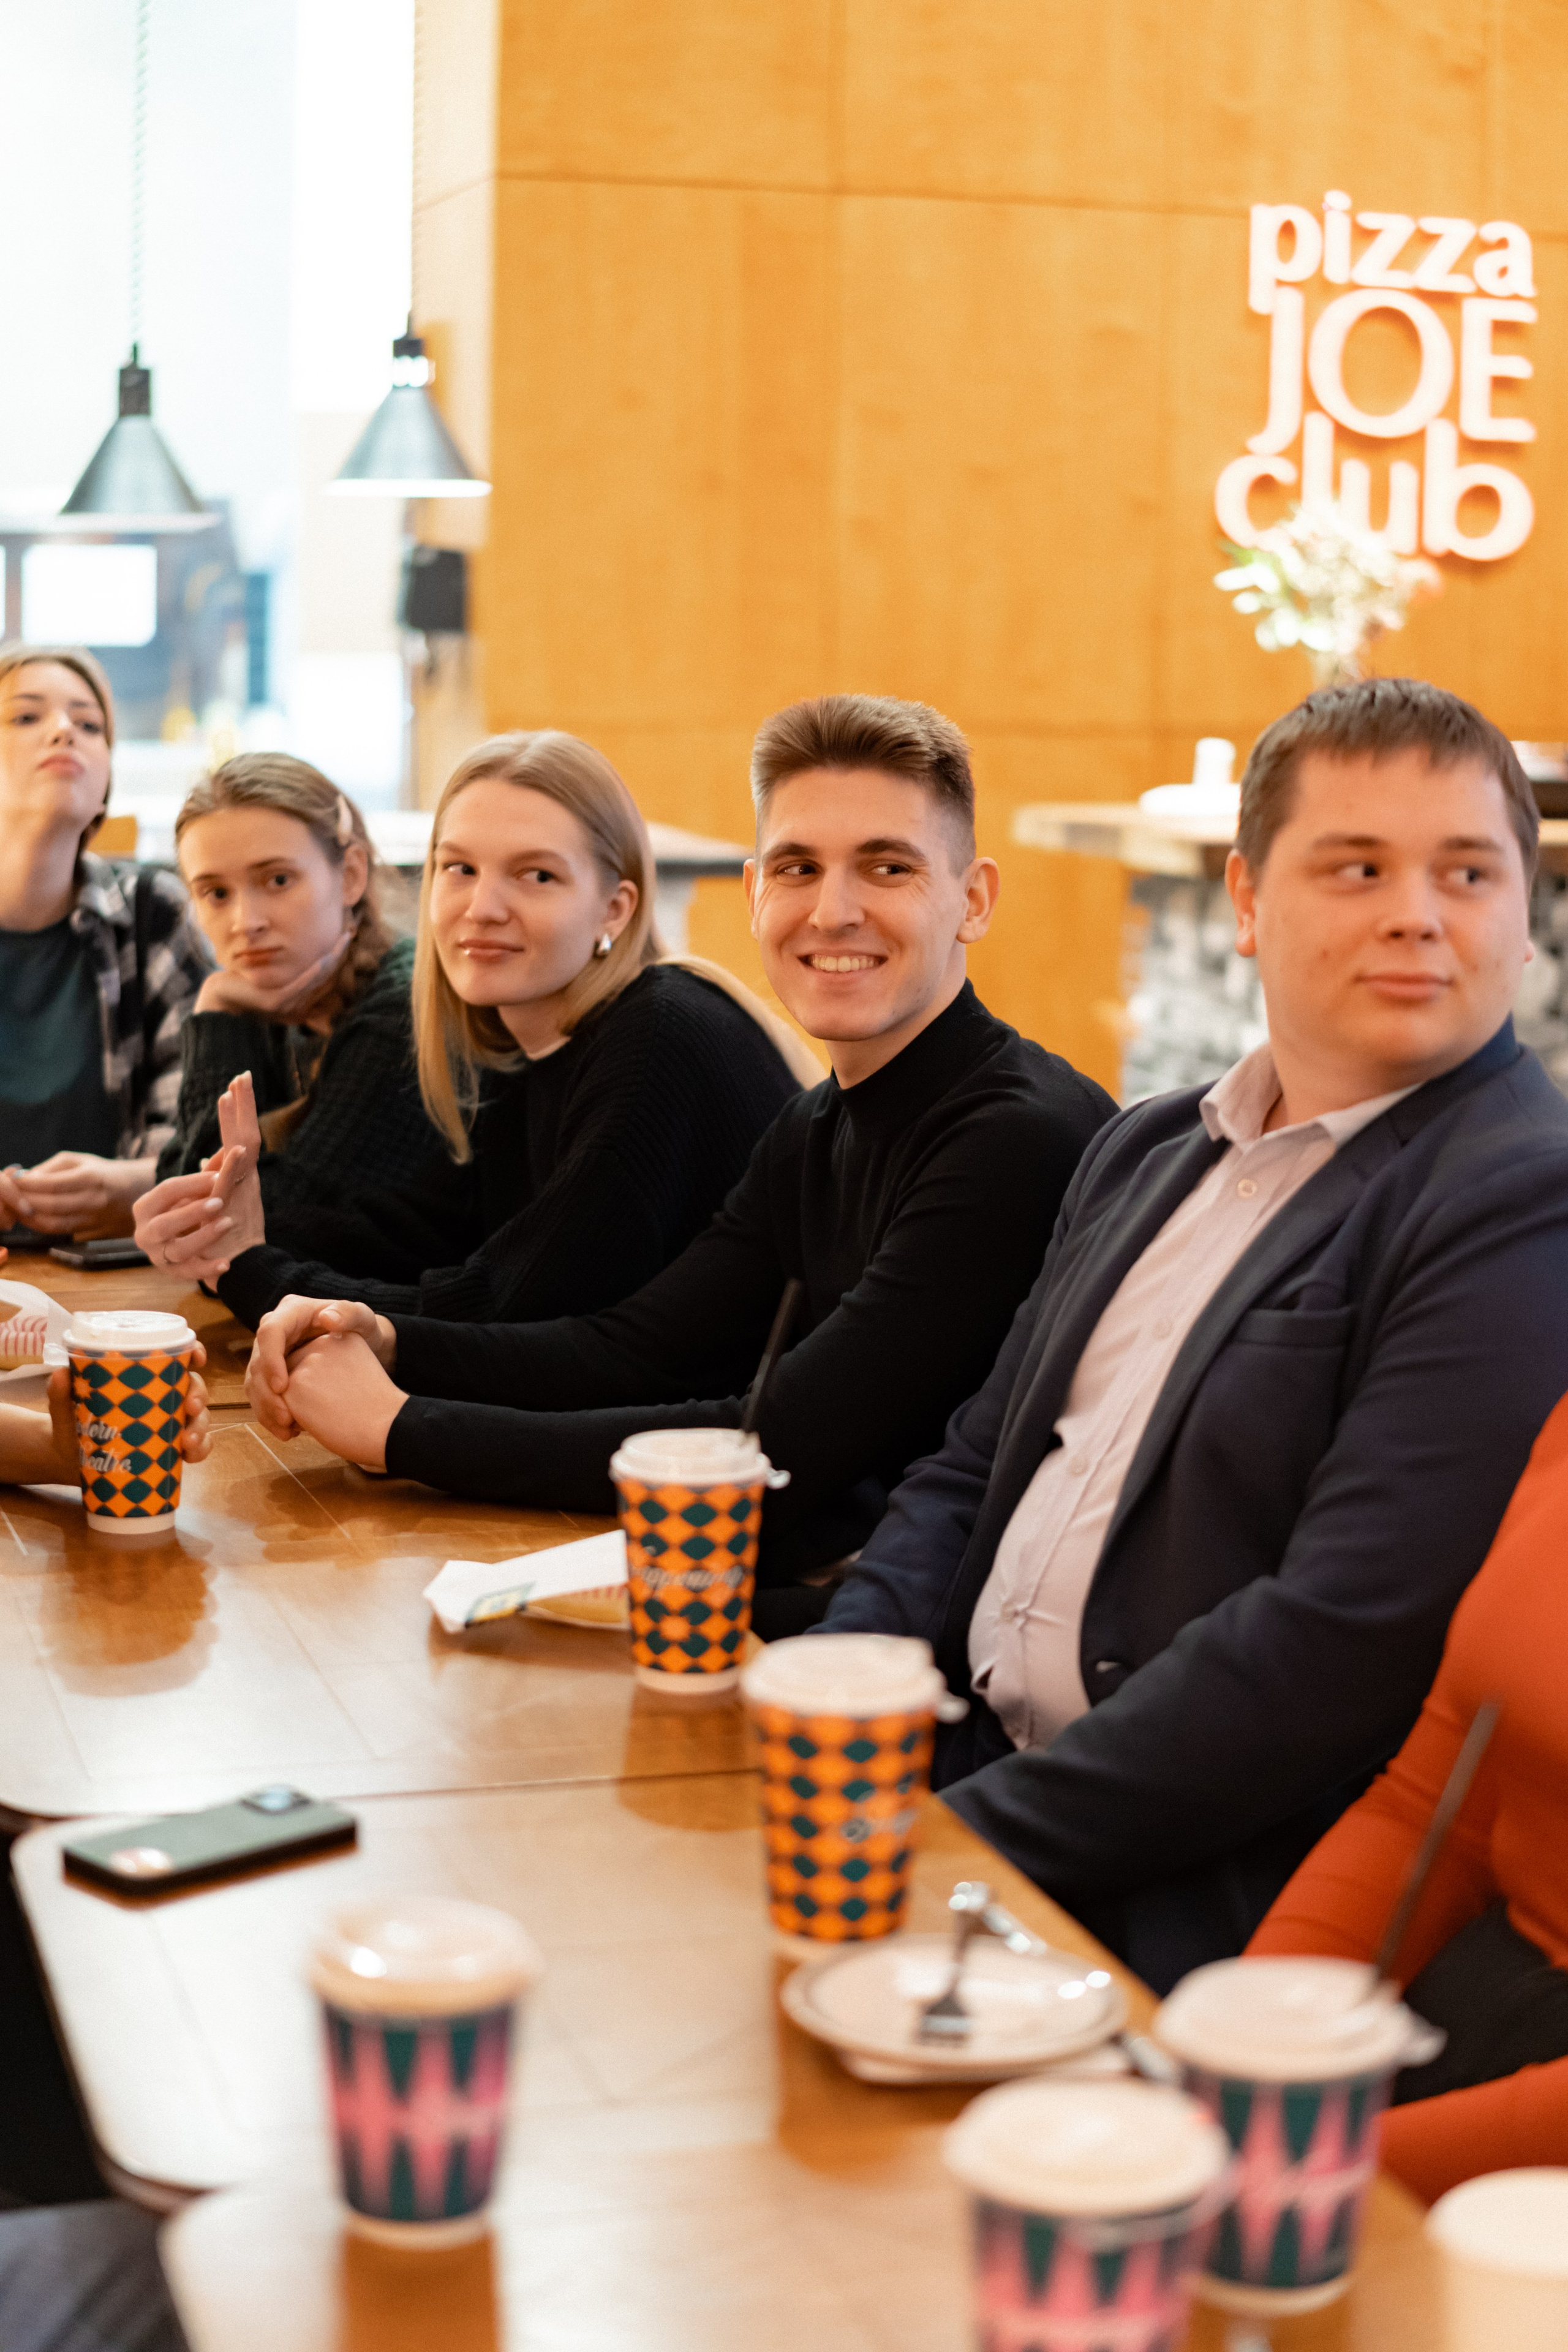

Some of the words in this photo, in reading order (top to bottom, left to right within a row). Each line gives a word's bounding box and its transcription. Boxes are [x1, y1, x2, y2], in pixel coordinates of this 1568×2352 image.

[1249, 190, 1537, 314] pizza
[1246, 287, 1537, 456] JOE
[1215, 411, 1534, 561] club
